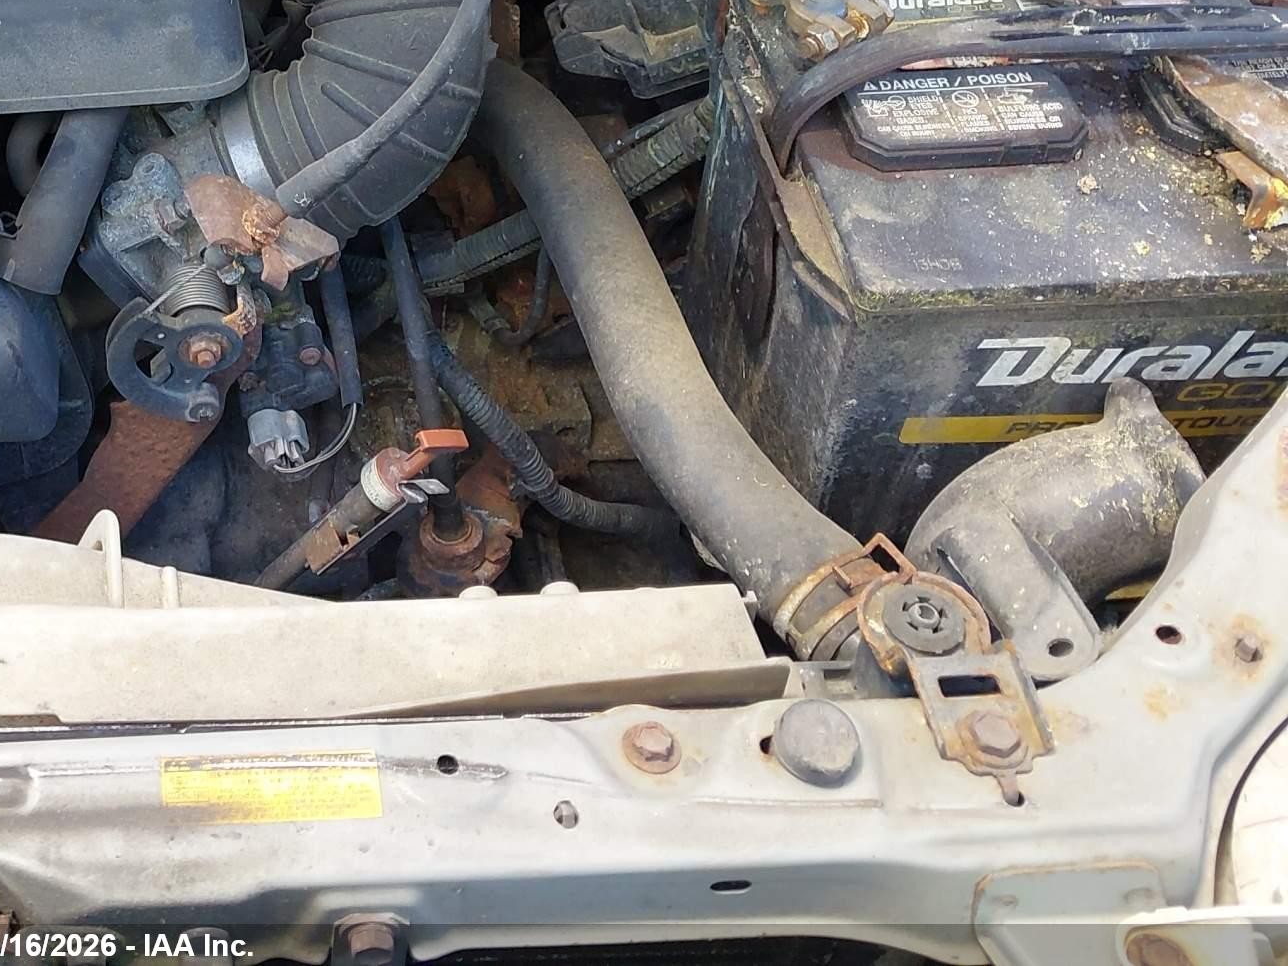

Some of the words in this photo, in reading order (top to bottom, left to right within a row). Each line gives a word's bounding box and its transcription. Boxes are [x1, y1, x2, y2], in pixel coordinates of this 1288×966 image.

[879, 75, 950, 91] DANGER
[954, 76, 962, 86] /
[967, 72, 1033, 85] POISON
[908, 95, 938, 103] SHIELD
[963, 107, 978, 115] NO
[998, 104, 1041, 113] SULFURIC
[1042, 102, 1064, 111] ACID
[893, 109, 940, 117] EXPLOSIVE
[1176, 380, 1283, 402] GO
